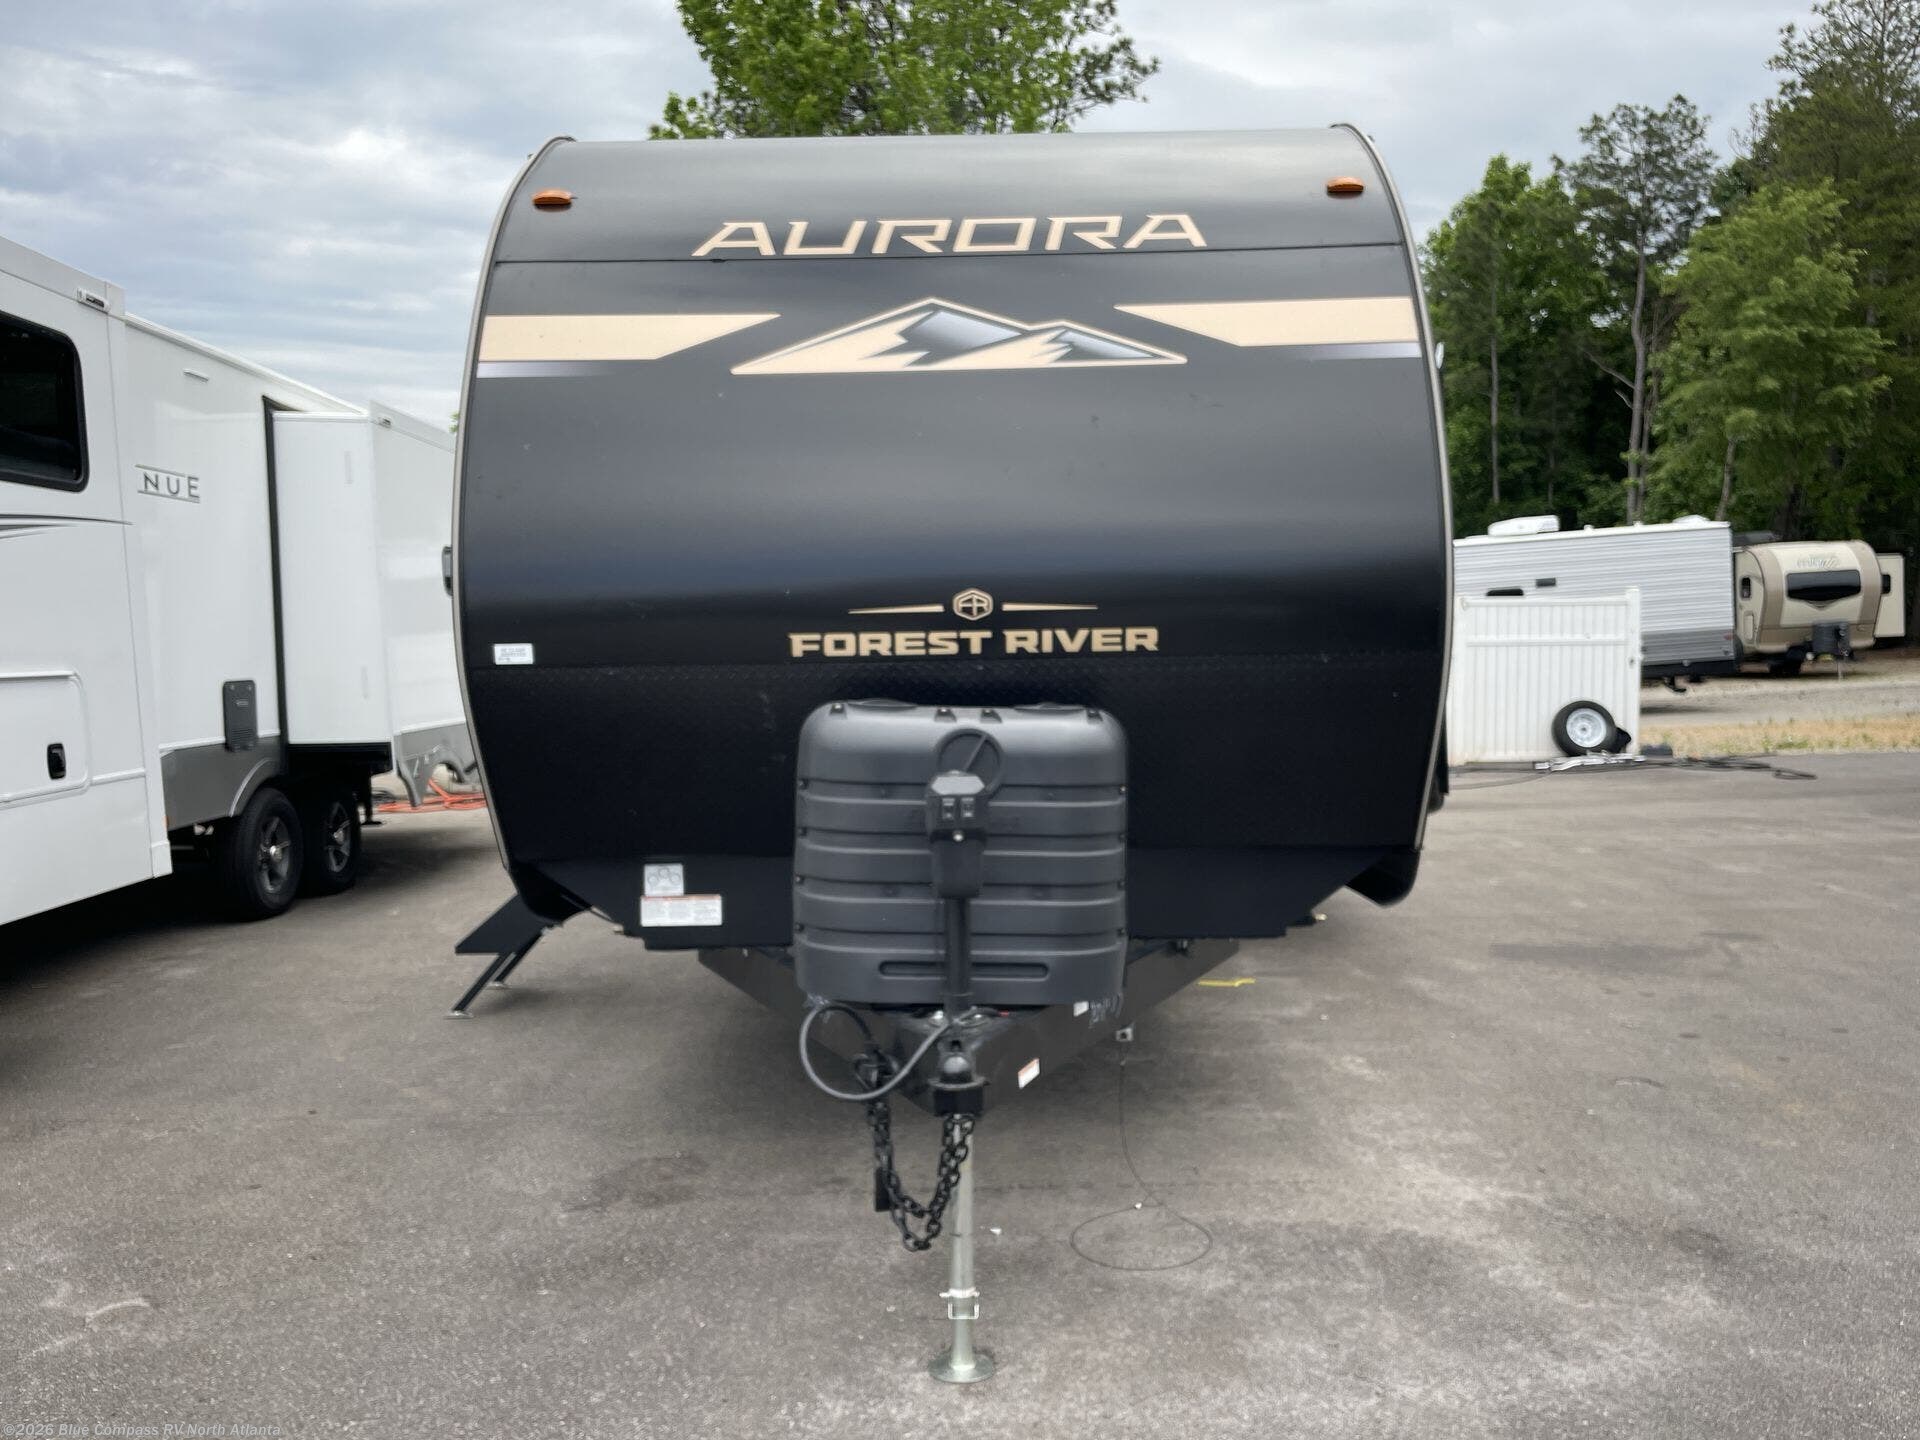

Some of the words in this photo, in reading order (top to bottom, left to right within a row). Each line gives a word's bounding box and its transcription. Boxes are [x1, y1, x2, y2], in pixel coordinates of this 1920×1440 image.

[690, 214, 1208, 256] AURORA
[143, 471, 200, 499] NUE
[788, 630, 993, 657] FOREST
[1002, 626, 1160, 654] RIVER
